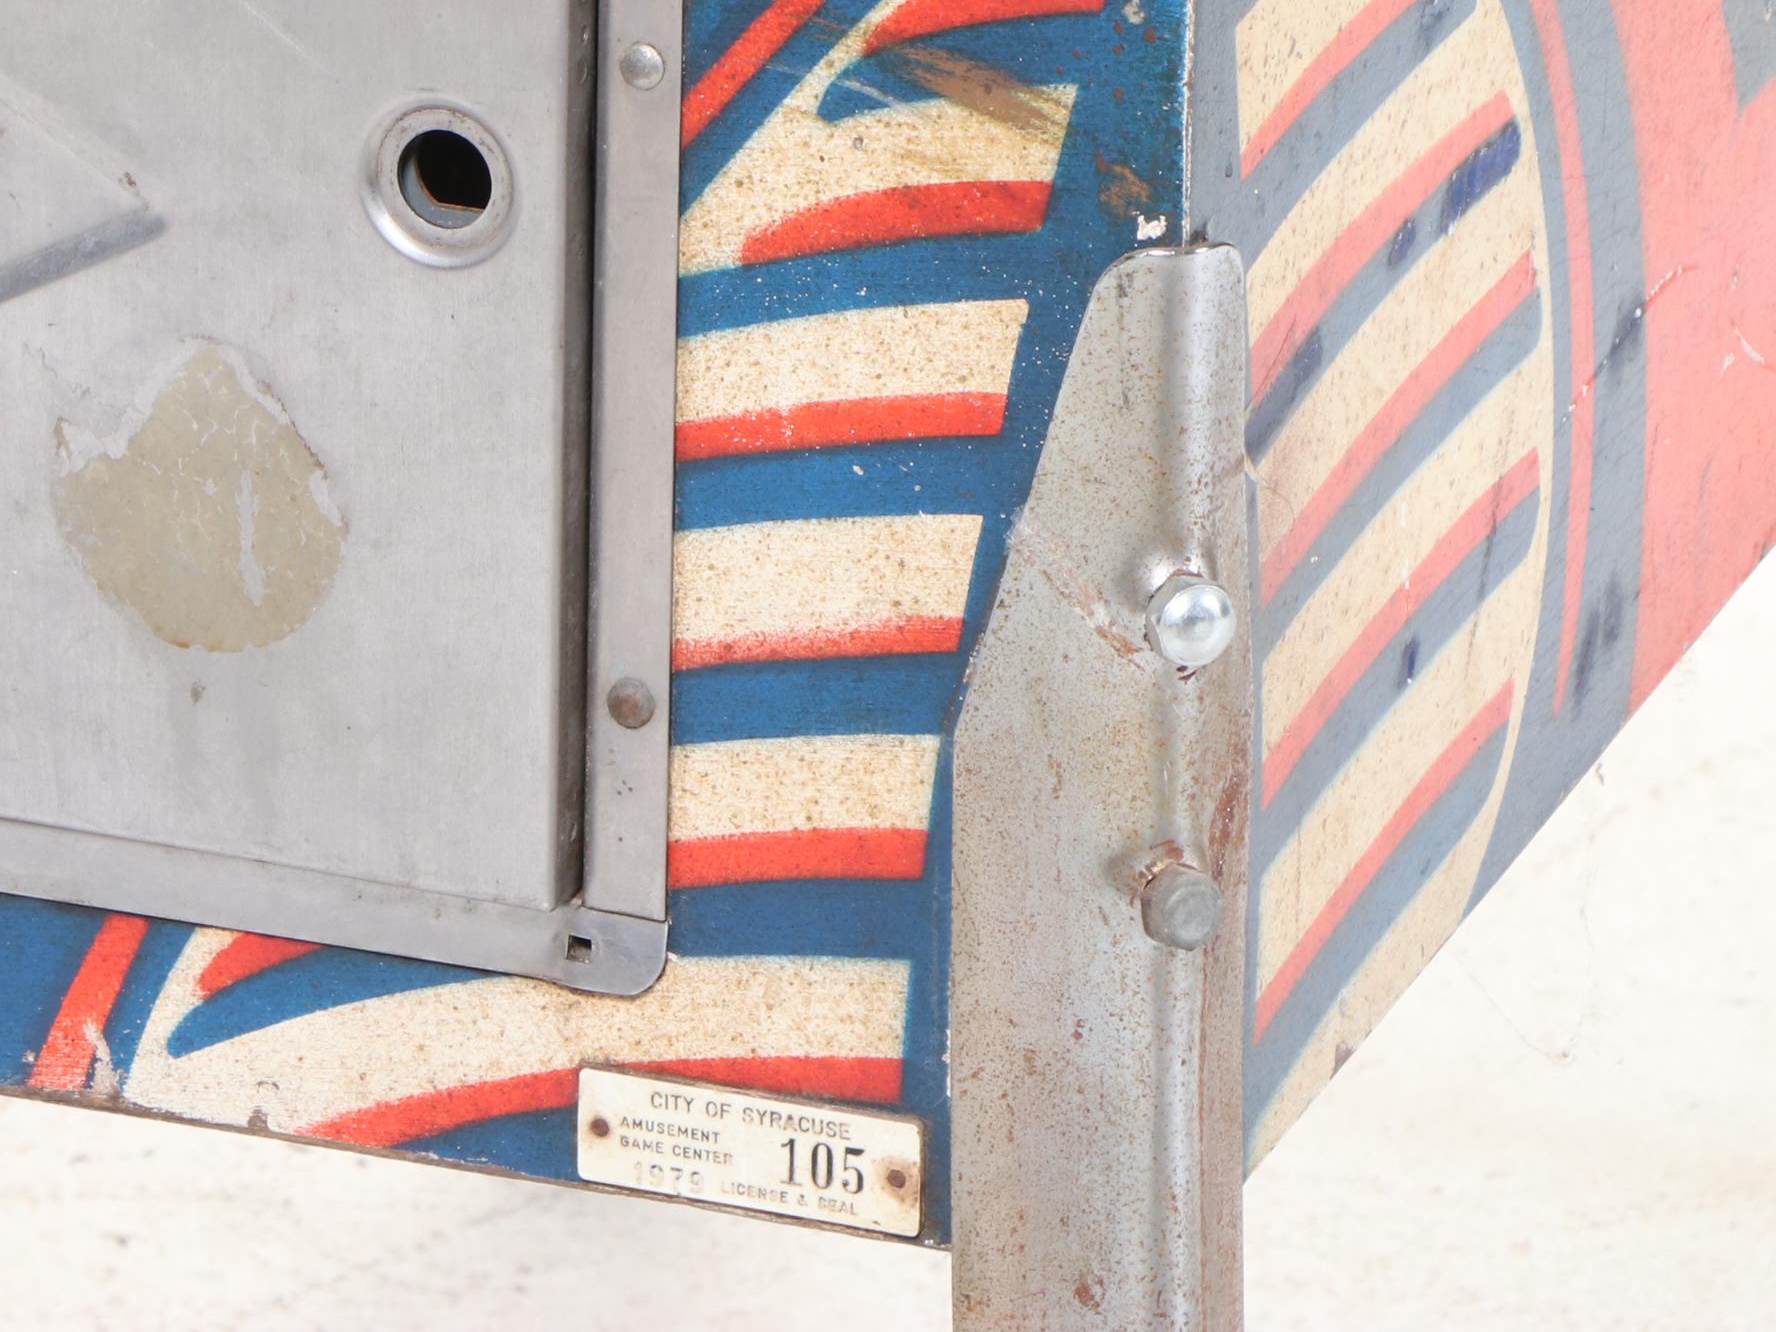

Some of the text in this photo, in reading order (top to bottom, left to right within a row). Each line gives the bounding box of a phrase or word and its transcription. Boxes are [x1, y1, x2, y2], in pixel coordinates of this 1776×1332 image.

[620, 1116, 721, 1145] AMUSEMENT
[650, 1092, 851, 1141] CITY OF SYRACUSE
[620, 1135, 734, 1166] GAME CENTER
[780, 1137, 865, 1195] 105
[721, 1181, 789, 1204] LICENSE
[817, 1196, 859, 1216] SEAL
